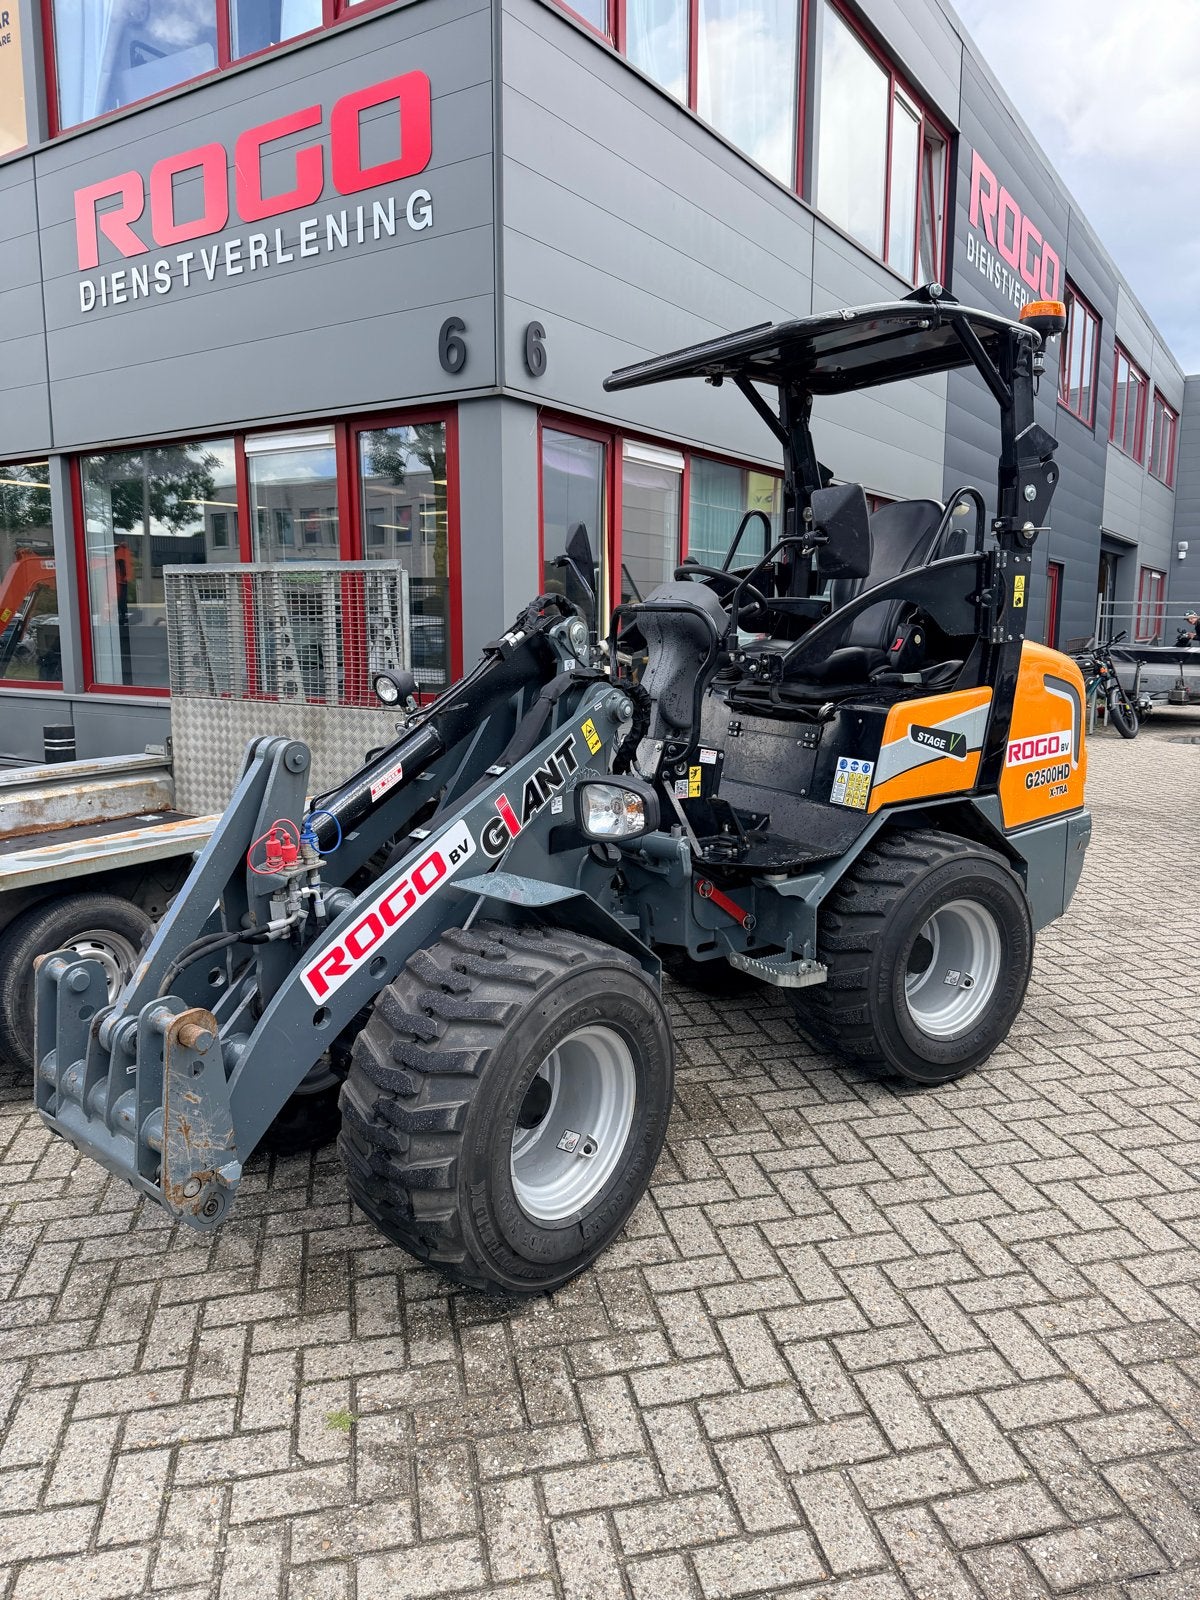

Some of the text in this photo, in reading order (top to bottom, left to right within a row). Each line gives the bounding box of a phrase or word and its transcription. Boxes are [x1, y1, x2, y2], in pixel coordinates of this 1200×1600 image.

[74, 70, 432, 271] ROGO
[79, 189, 434, 312] DIENSTVERLENING
[968, 148, 1060, 302] ROGO
[967, 232, 1038, 311] DIENSTVER
[439, 316, 467, 374] 6
[525, 320, 548, 378] 6
[917, 731, 964, 752] STAGE V
[1008, 736, 1070, 763] ROGO BV
[1025, 763, 1070, 790] G2500HD
[307, 838, 468, 997] ROGO BV
